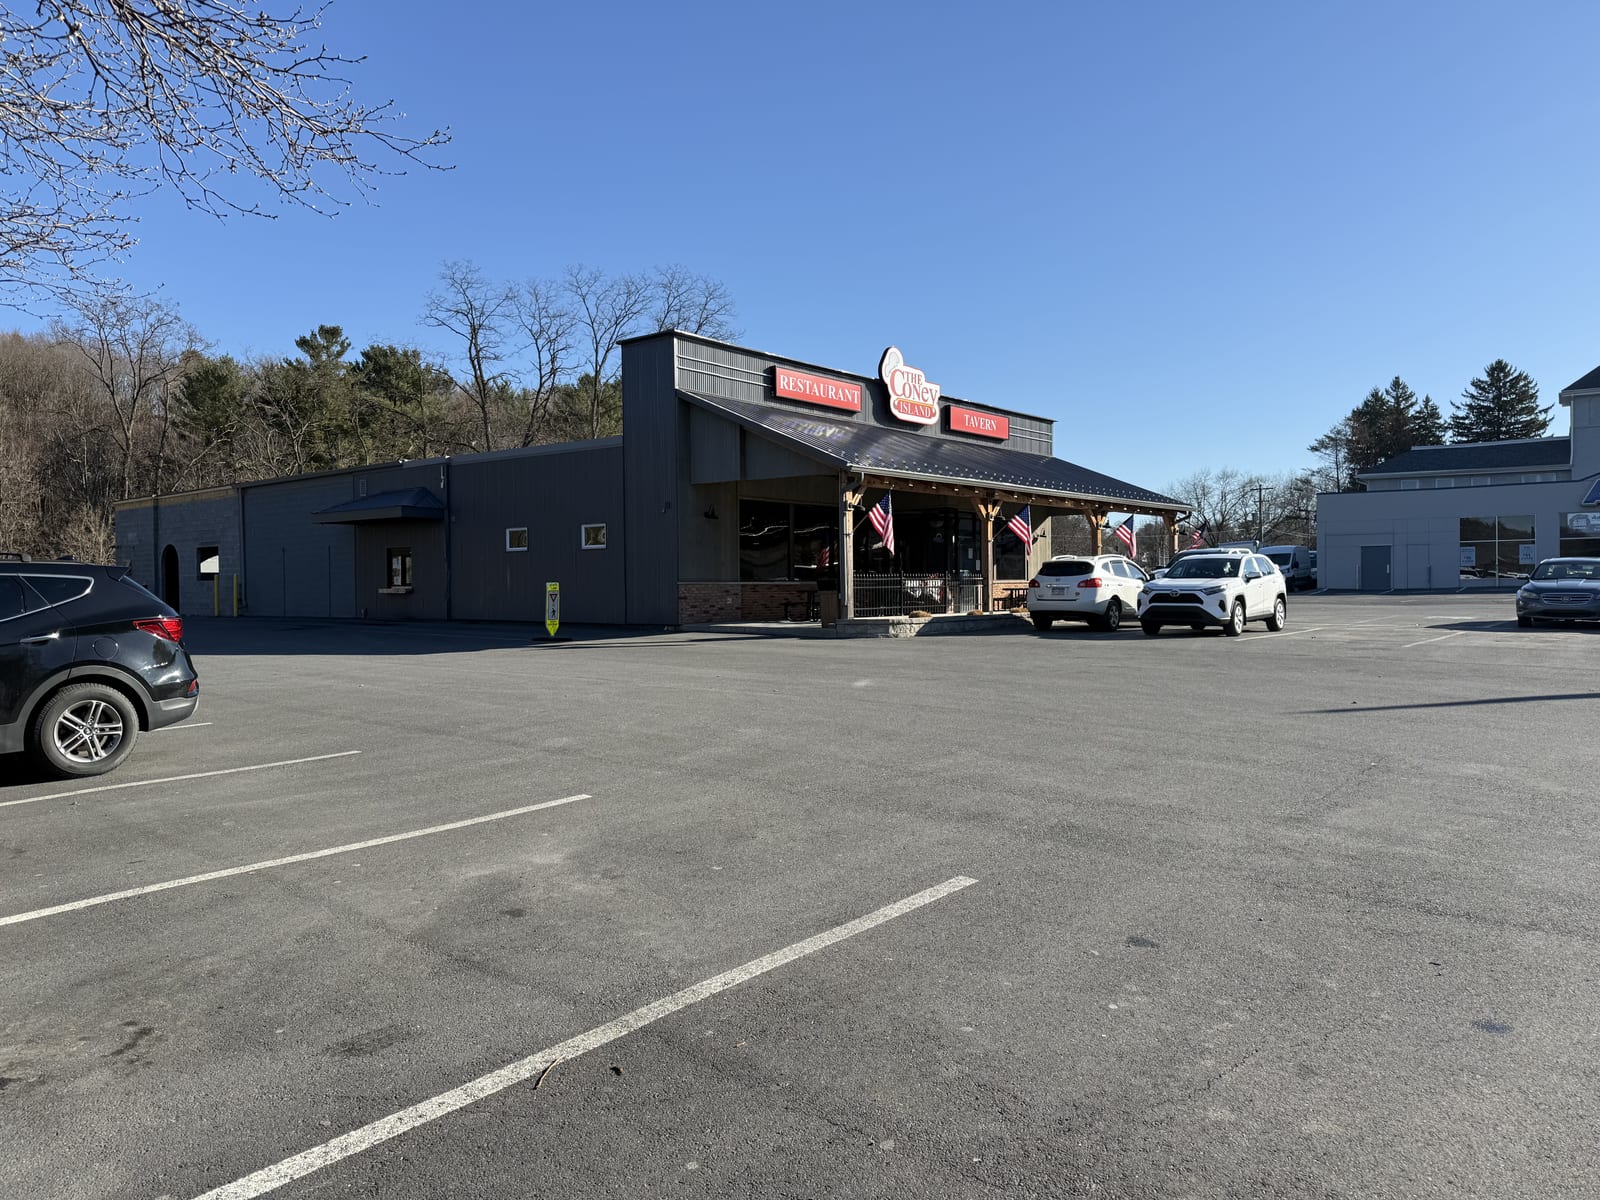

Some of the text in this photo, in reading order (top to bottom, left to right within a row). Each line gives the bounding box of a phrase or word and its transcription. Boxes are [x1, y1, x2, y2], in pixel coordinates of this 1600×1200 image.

[903, 371, 923, 386] THE
[779, 374, 860, 405] RESTAURANT
[899, 401, 932, 418] ISLAND
[964, 414, 997, 431] TAVERN
